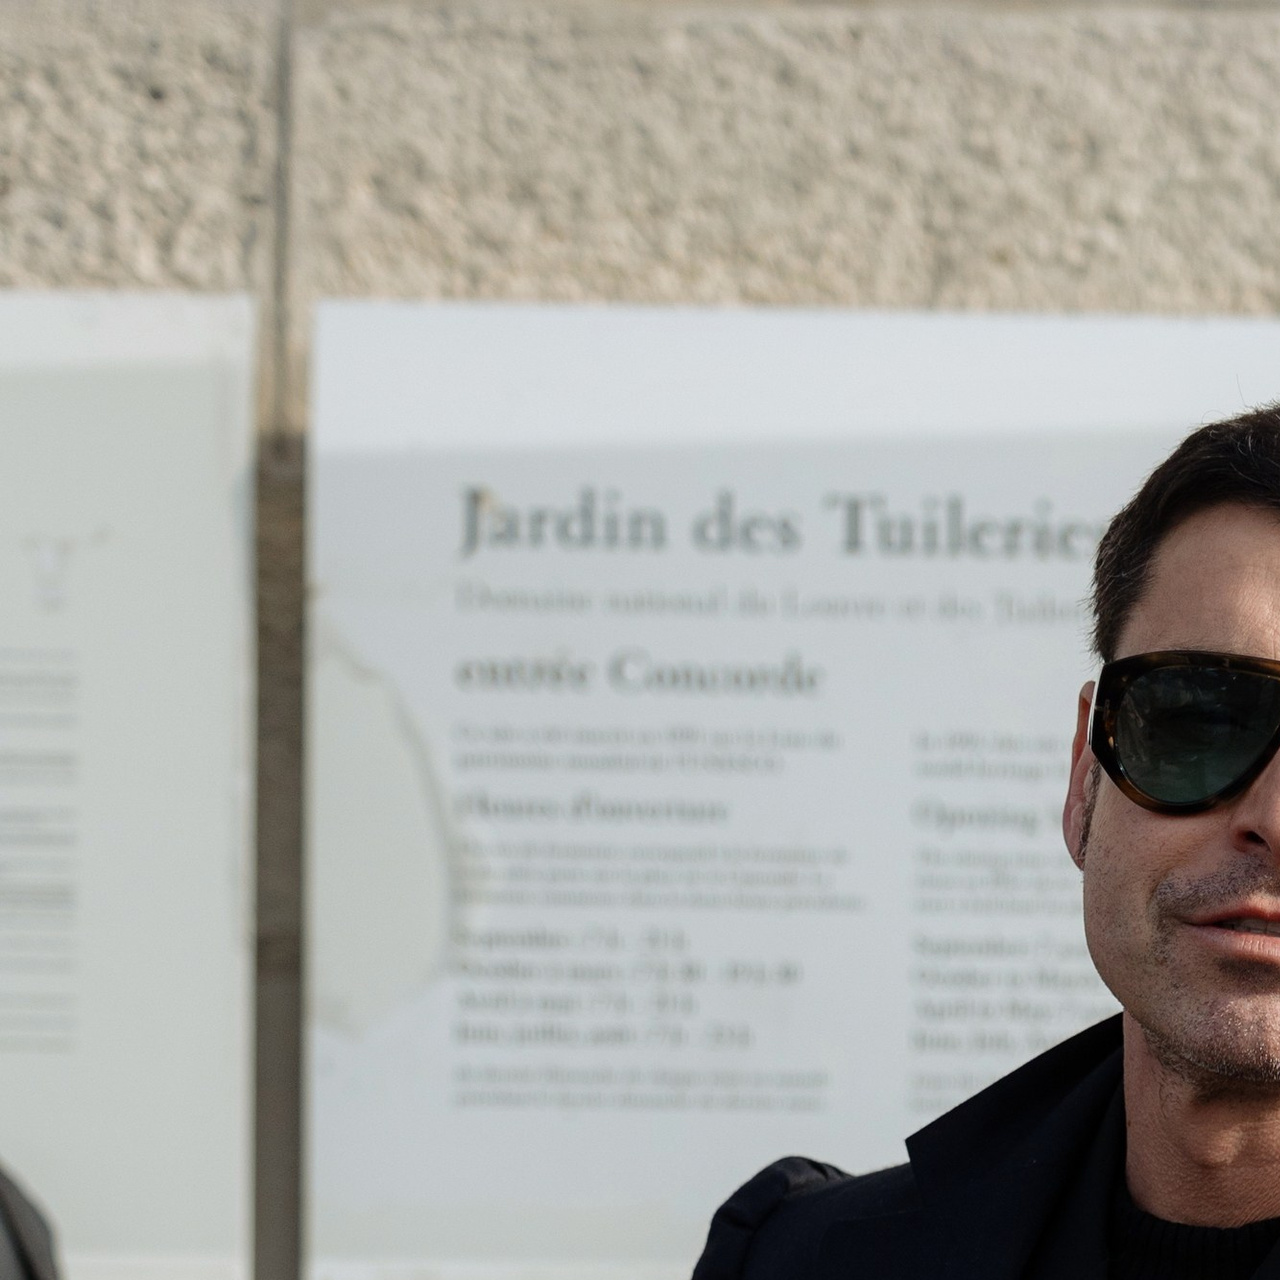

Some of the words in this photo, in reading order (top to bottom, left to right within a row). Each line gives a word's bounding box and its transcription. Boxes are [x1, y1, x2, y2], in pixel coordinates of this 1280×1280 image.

[456, 483, 669, 561] Jardin
[690, 487, 804, 556] des
[453, 648, 597, 694] entrée
[606, 645, 824, 698] Concorde
